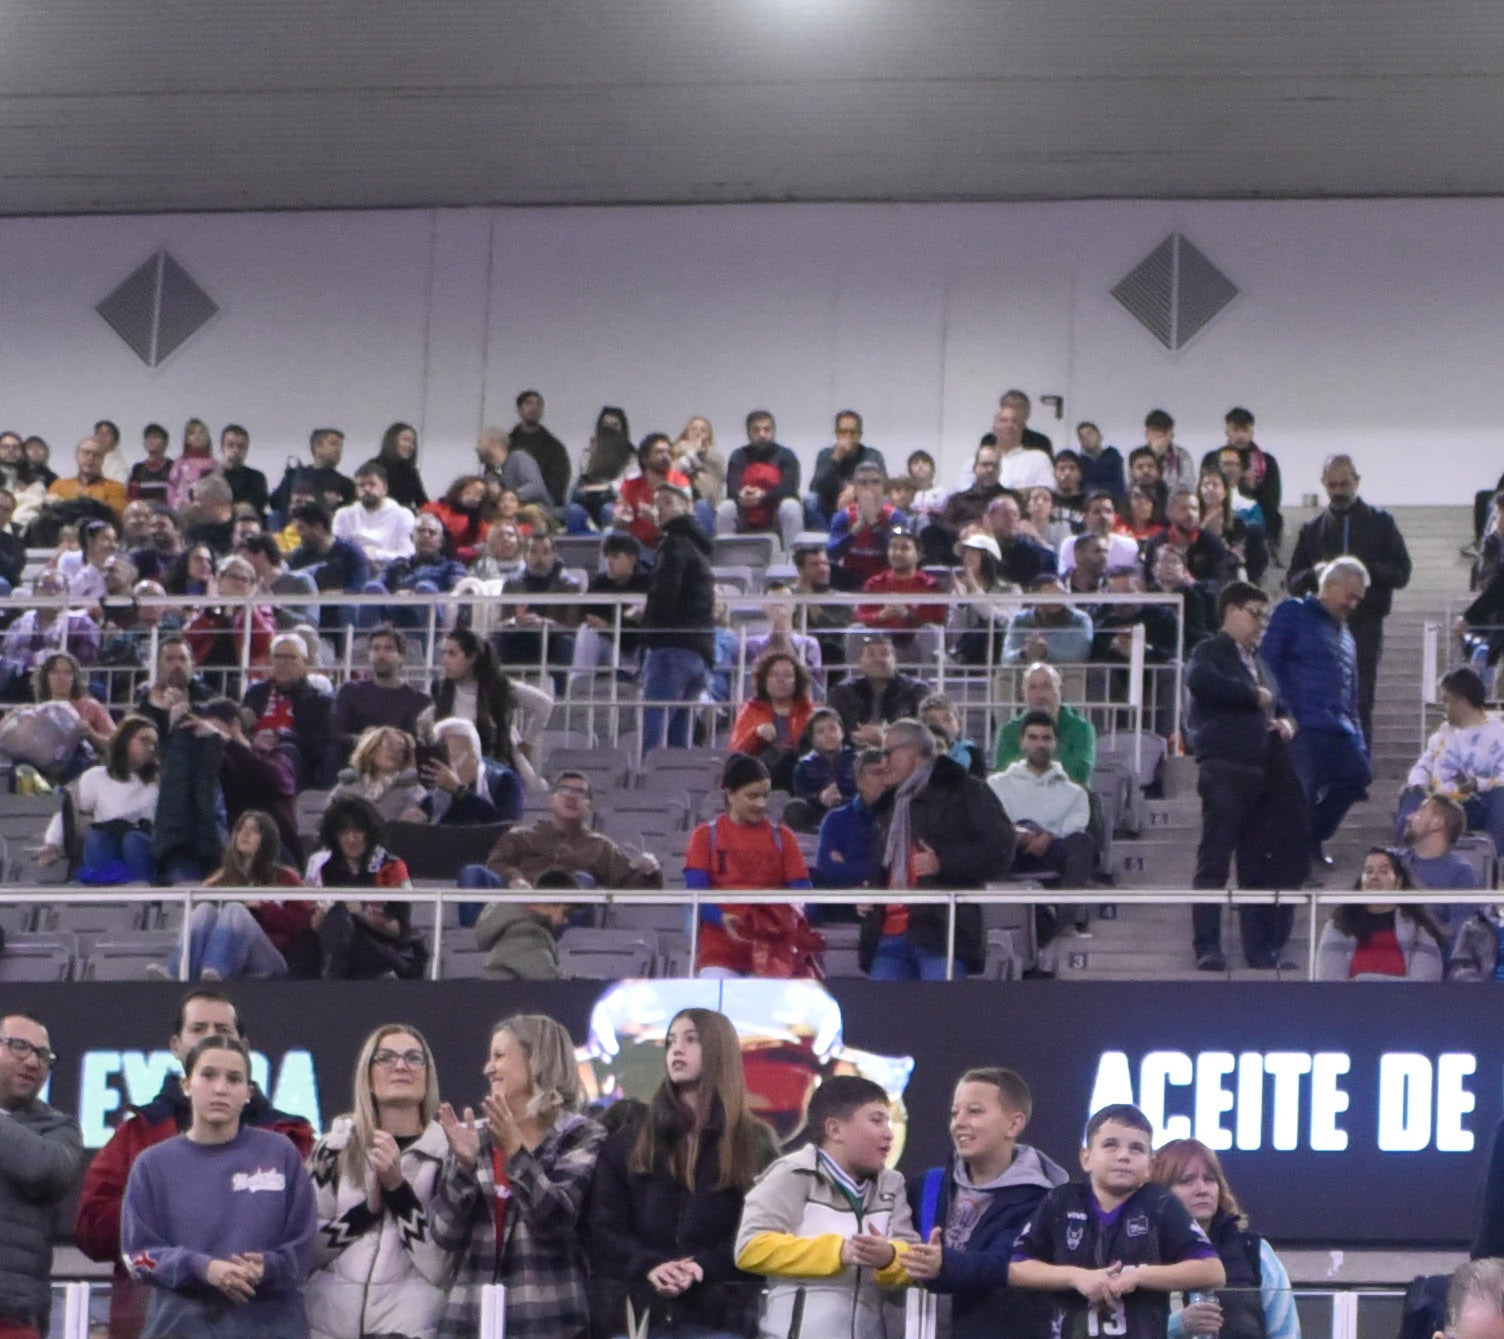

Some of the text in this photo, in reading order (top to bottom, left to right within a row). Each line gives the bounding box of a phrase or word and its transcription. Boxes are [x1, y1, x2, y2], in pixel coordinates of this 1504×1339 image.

[80, 1050, 324, 1149] EXA
[1084, 1051, 1351, 1151] ACEITE
[1377, 1052, 1477, 1152] DE
[1088, 1299, 1128, 1337] 13
